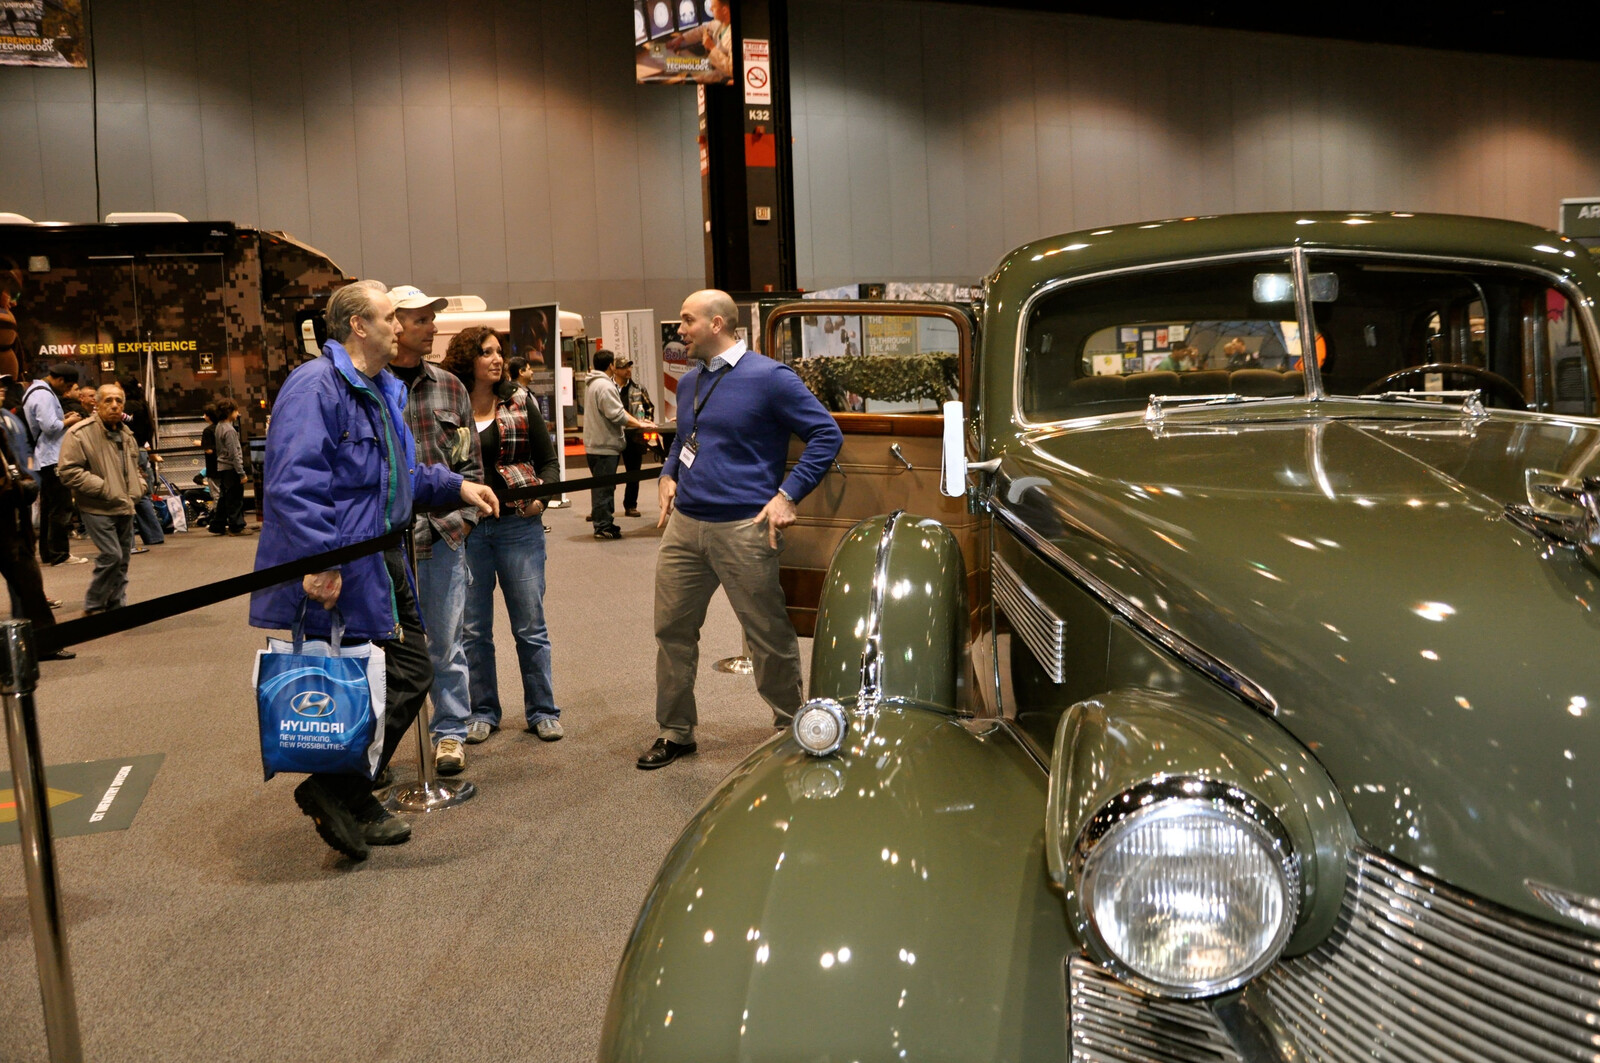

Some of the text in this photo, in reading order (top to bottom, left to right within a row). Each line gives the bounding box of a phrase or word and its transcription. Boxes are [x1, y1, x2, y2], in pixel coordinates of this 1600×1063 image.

[701, 58, 710, 66] OF
[749, 110, 770, 121] K32
[955, 287, 969, 299] ARE
[879, 337, 911, 345] THROUGH
[39, 340, 197, 356] ARMY STEM EXPERIENCE
[870, 345, 884, 353] THE
[280, 719, 345, 734] HYUNDAI
[297, 734, 332, 743] THINKING.
[279, 741, 346, 751] NEW POSSIBILITIES.
